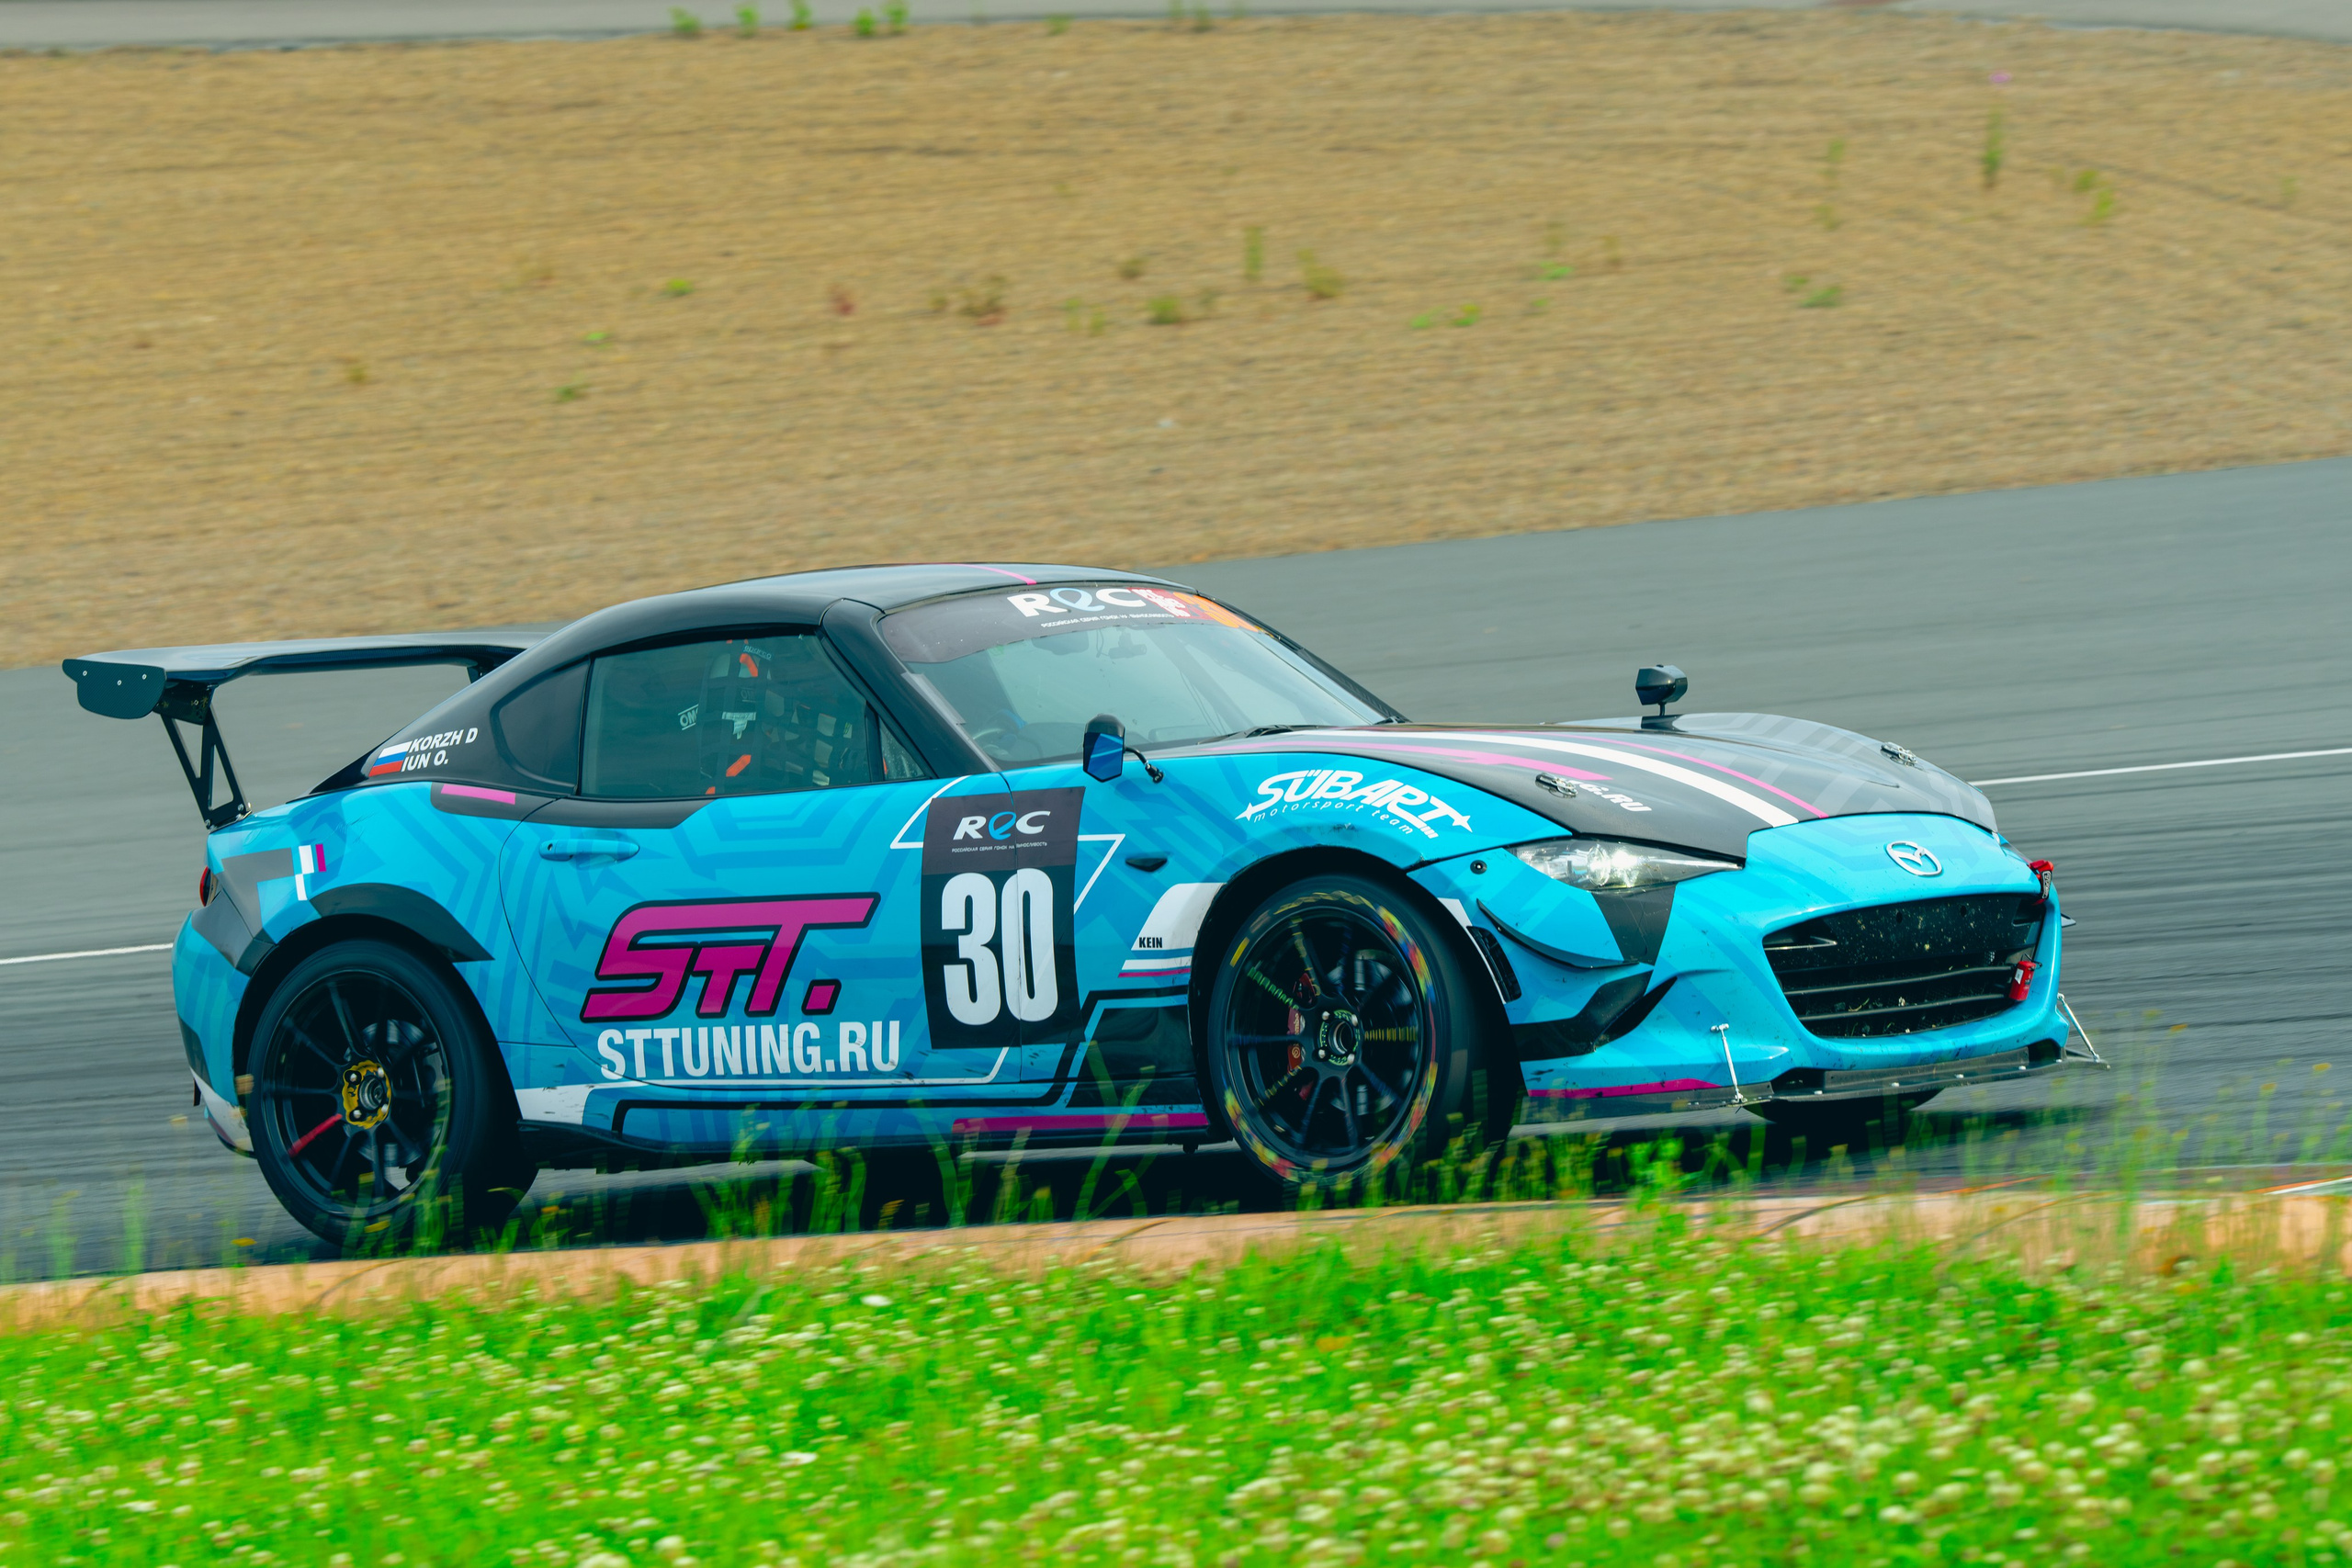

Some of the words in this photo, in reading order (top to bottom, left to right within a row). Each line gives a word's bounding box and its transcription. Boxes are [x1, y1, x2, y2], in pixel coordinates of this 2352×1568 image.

[679, 706, 699, 727] OM
[408, 729, 464, 753] KORZH
[465, 728, 479, 744] D
[401, 752, 431, 773] IUN
[434, 750, 449, 766] O.
[1254, 800, 1363, 823] motorsport
[1372, 809, 1414, 835] team
[942, 868, 1058, 1026] 30
[1138, 936, 1163, 949] KEIN
[597, 1020, 900, 1080] STTUNING.RU
